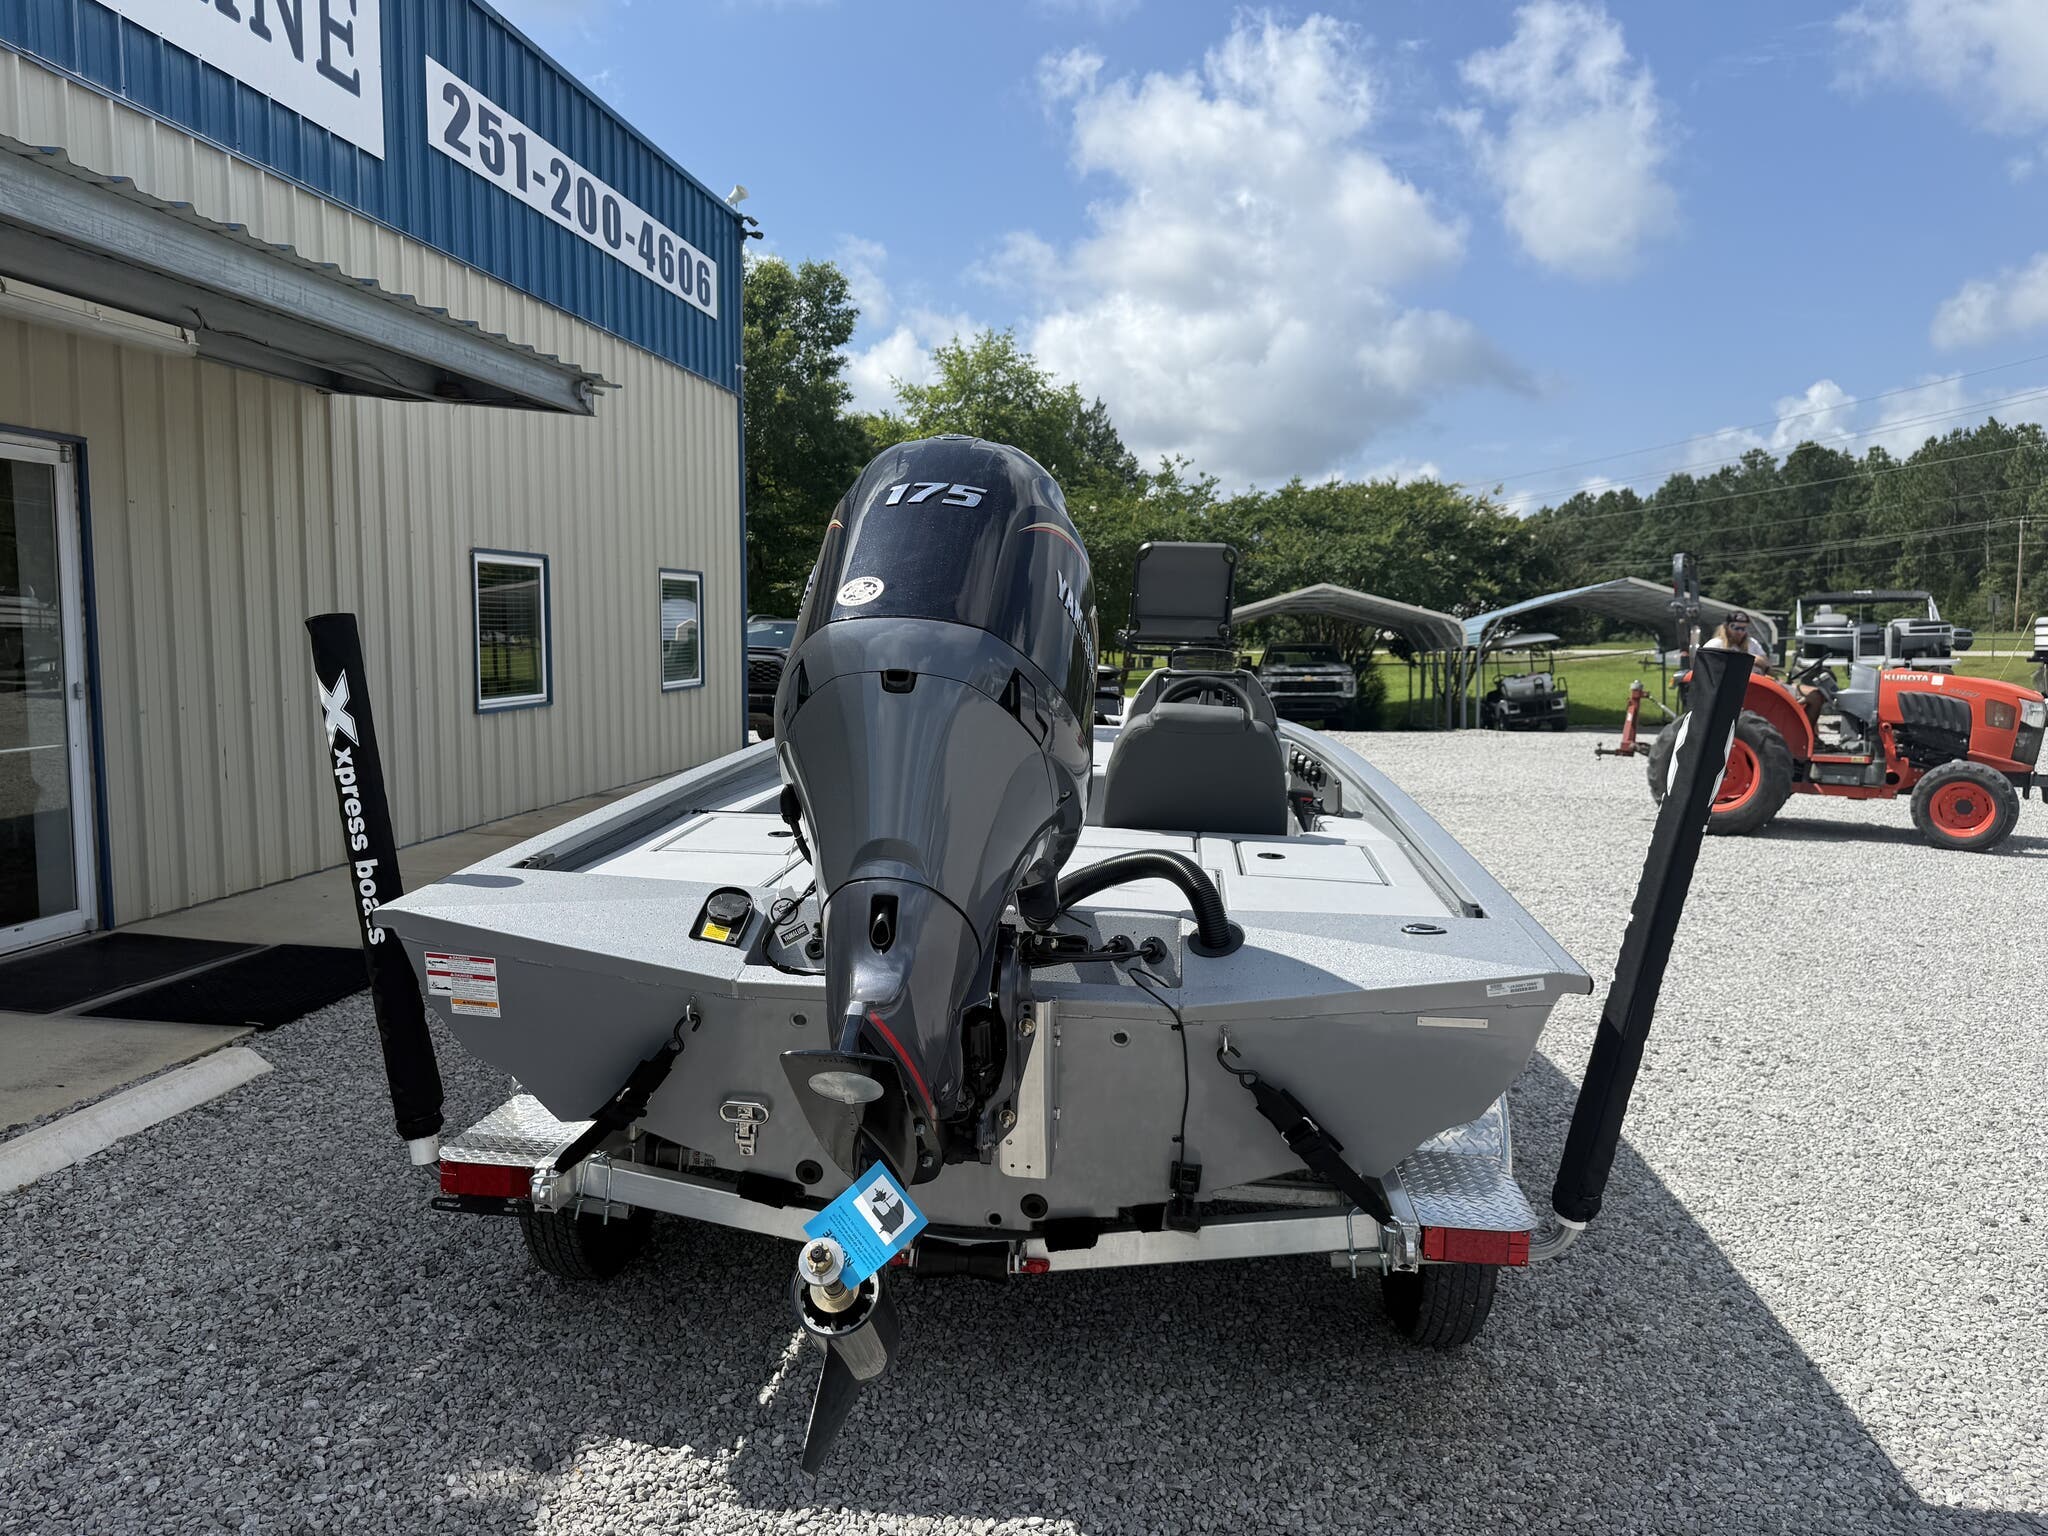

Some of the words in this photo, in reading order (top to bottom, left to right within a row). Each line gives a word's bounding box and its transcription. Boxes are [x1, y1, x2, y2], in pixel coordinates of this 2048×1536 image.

[442, 82, 711, 307] 251-200-4606
[885, 482, 988, 507] 175
[1884, 674, 1929, 682] KUBOTA
[334, 746, 368, 852] xpress
[355, 858, 386, 945] boas
